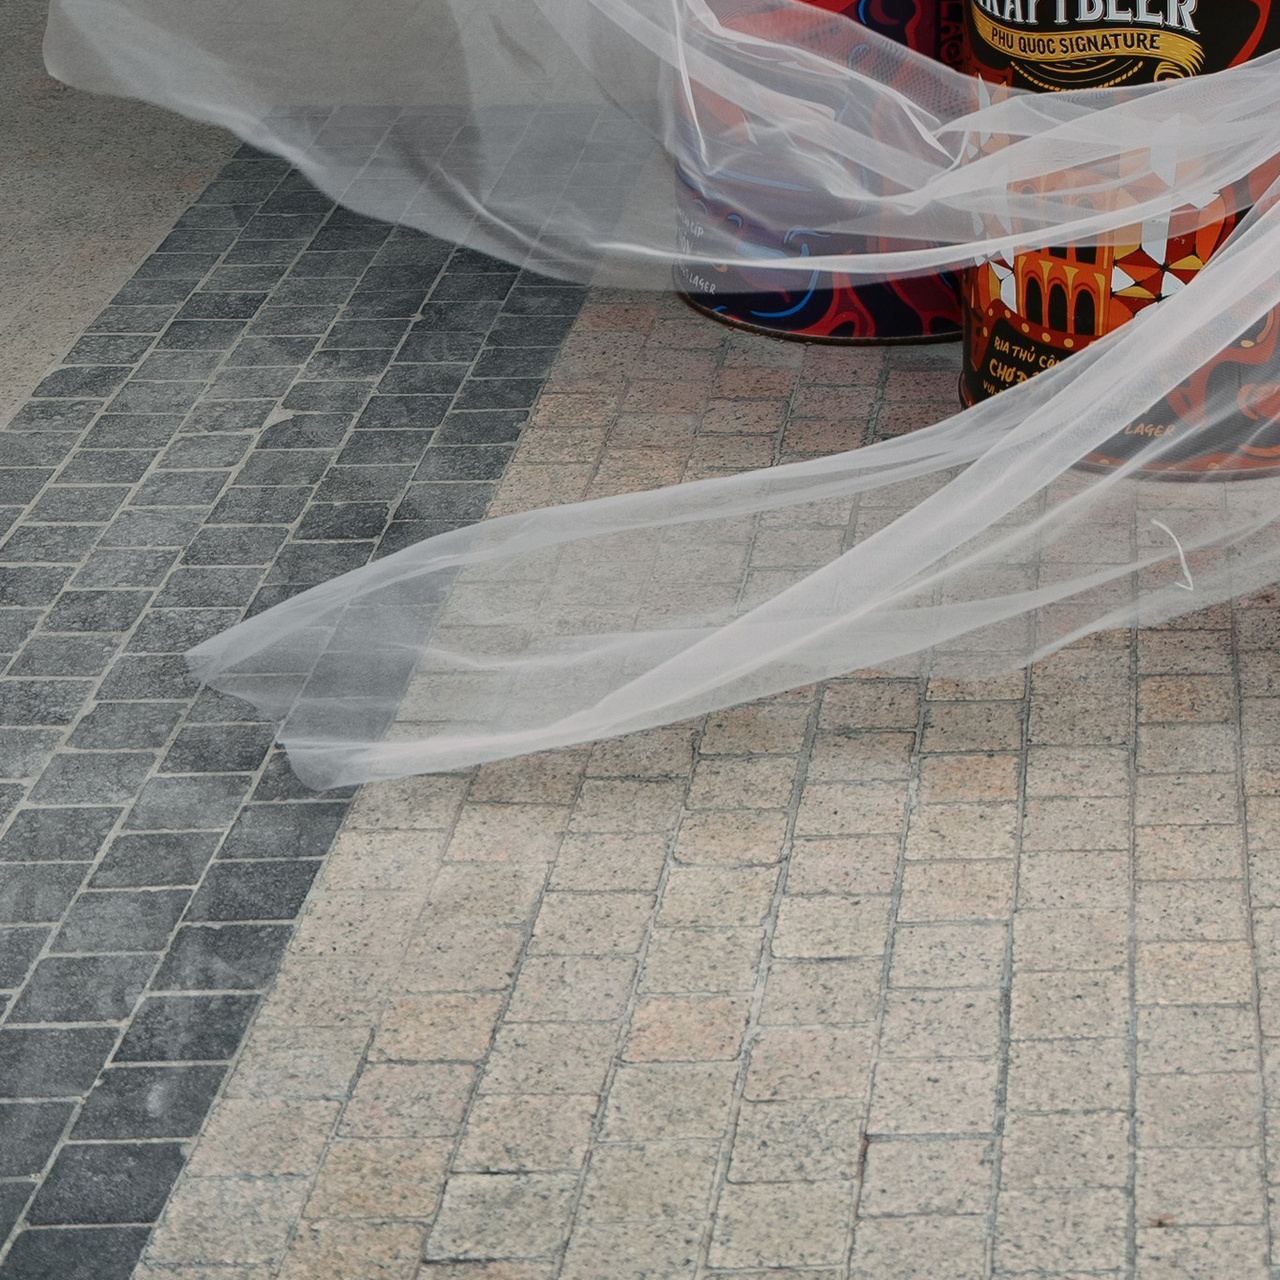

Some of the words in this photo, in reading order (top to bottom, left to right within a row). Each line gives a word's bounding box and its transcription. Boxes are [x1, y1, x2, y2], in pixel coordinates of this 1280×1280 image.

[991, 27, 1014, 50] PHU
[1018, 37, 1056, 54] QUOC
[1058, 33, 1161, 53] SIGNATURE
[994, 336, 1009, 354] BIA
[1012, 346, 1036, 363] THỦ
